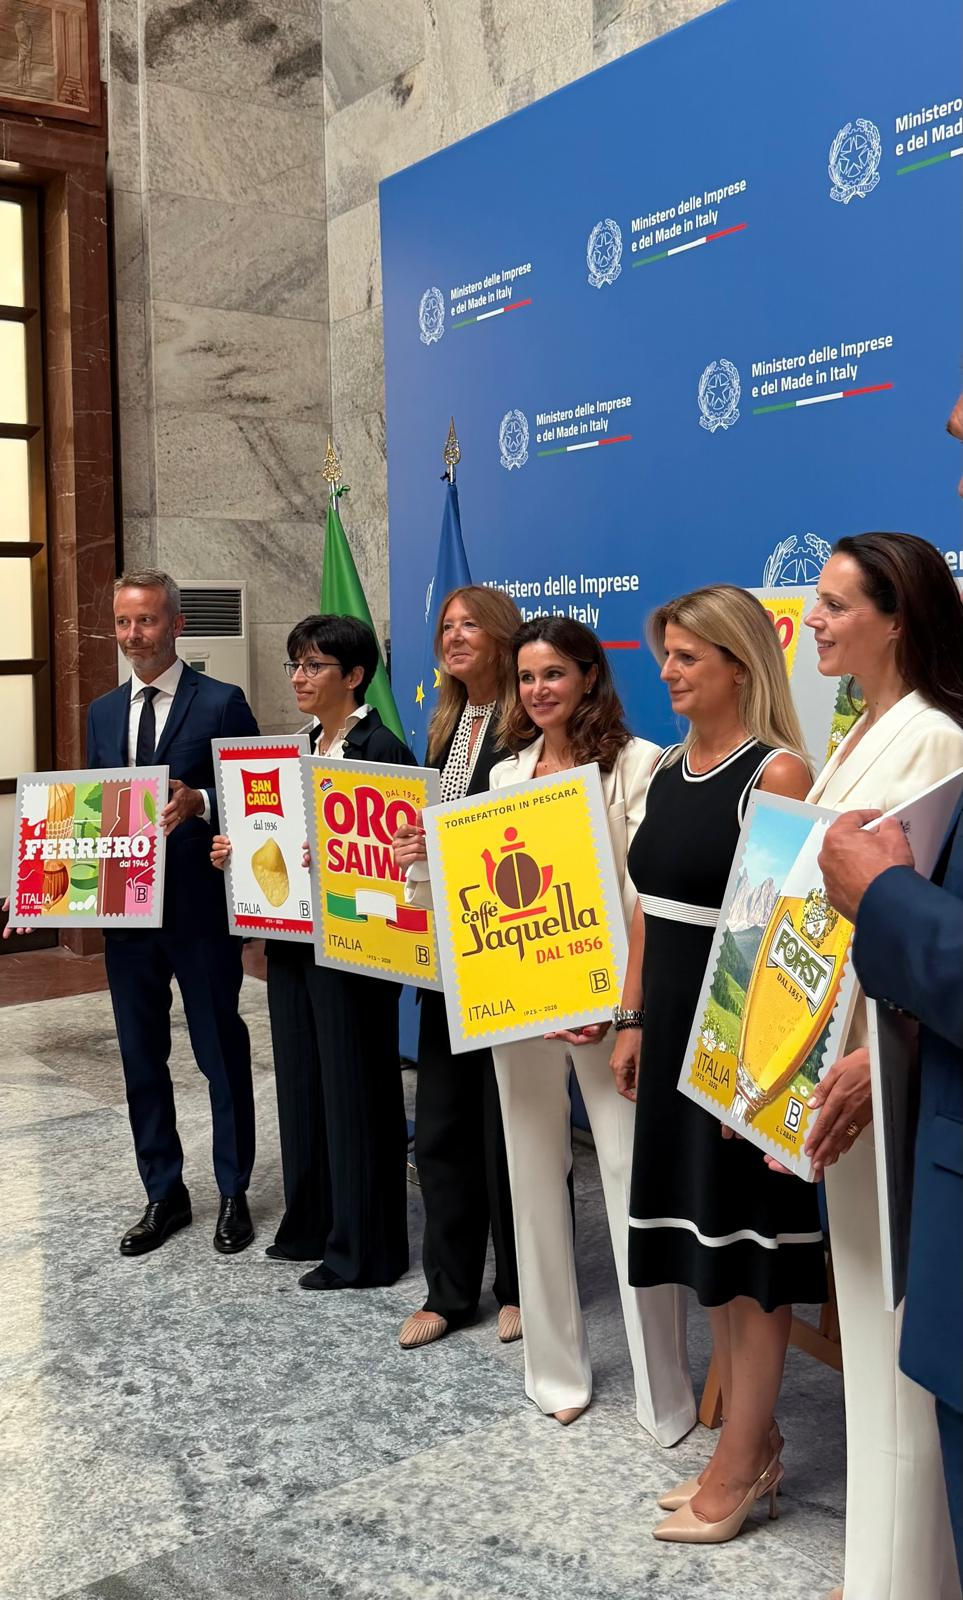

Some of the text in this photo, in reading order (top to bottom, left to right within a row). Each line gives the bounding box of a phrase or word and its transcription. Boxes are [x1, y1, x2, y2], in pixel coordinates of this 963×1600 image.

[896, 98, 963, 133] Ministero
[896, 143, 904, 156] e
[907, 130, 928, 152] del
[631, 179, 747, 233] Ministero delle Imprese
[631, 209, 718, 252] e del Made in Italy
[450, 262, 532, 300] Ministero delle Imprese
[451, 285, 512, 316] e del Made in Italy
[752, 335, 893, 378] Ministero delle Imprese
[752, 363, 858, 398] e del Made in Italy
[536, 396, 632, 426] Ministero delle Imprese
[536, 417, 609, 443] e del Made in Italy
[544, 575, 577, 596] delle
[580, 574, 640, 598] Imprese
[568, 603, 600, 629] Italy
[246, 792, 279, 806] CARLO
[251, 779, 272, 793] SAN
[385, 789, 421, 804] DAL 1956
[323, 786, 418, 846] ORO
[445, 787, 578, 829] TORREFATTORI IN PESCARA
[253, 819, 278, 831] dal 1936
[24, 835, 151, 860] FERRERO
[327, 838, 407, 883] SAIW
[119, 859, 149, 868] dal 1946
[21, 892, 51, 905] ITALIA
[136, 886, 147, 901] B
[237, 902, 262, 915] ITALIA
[300, 902, 310, 917] B
[458, 882, 600, 962] Saquella
[328, 933, 363, 952] ITALIA
[417, 947, 428, 963] B
[536, 936, 603, 964] DAL 1856
[774, 928, 828, 994] FORST
[591, 971, 608, 991] B
[776, 973, 803, 1003] DAL 1857
[468, 998, 516, 1022] ITALIA
[697, 1051, 730, 1089] ITALIA
[786, 1100, 801, 1127] B
